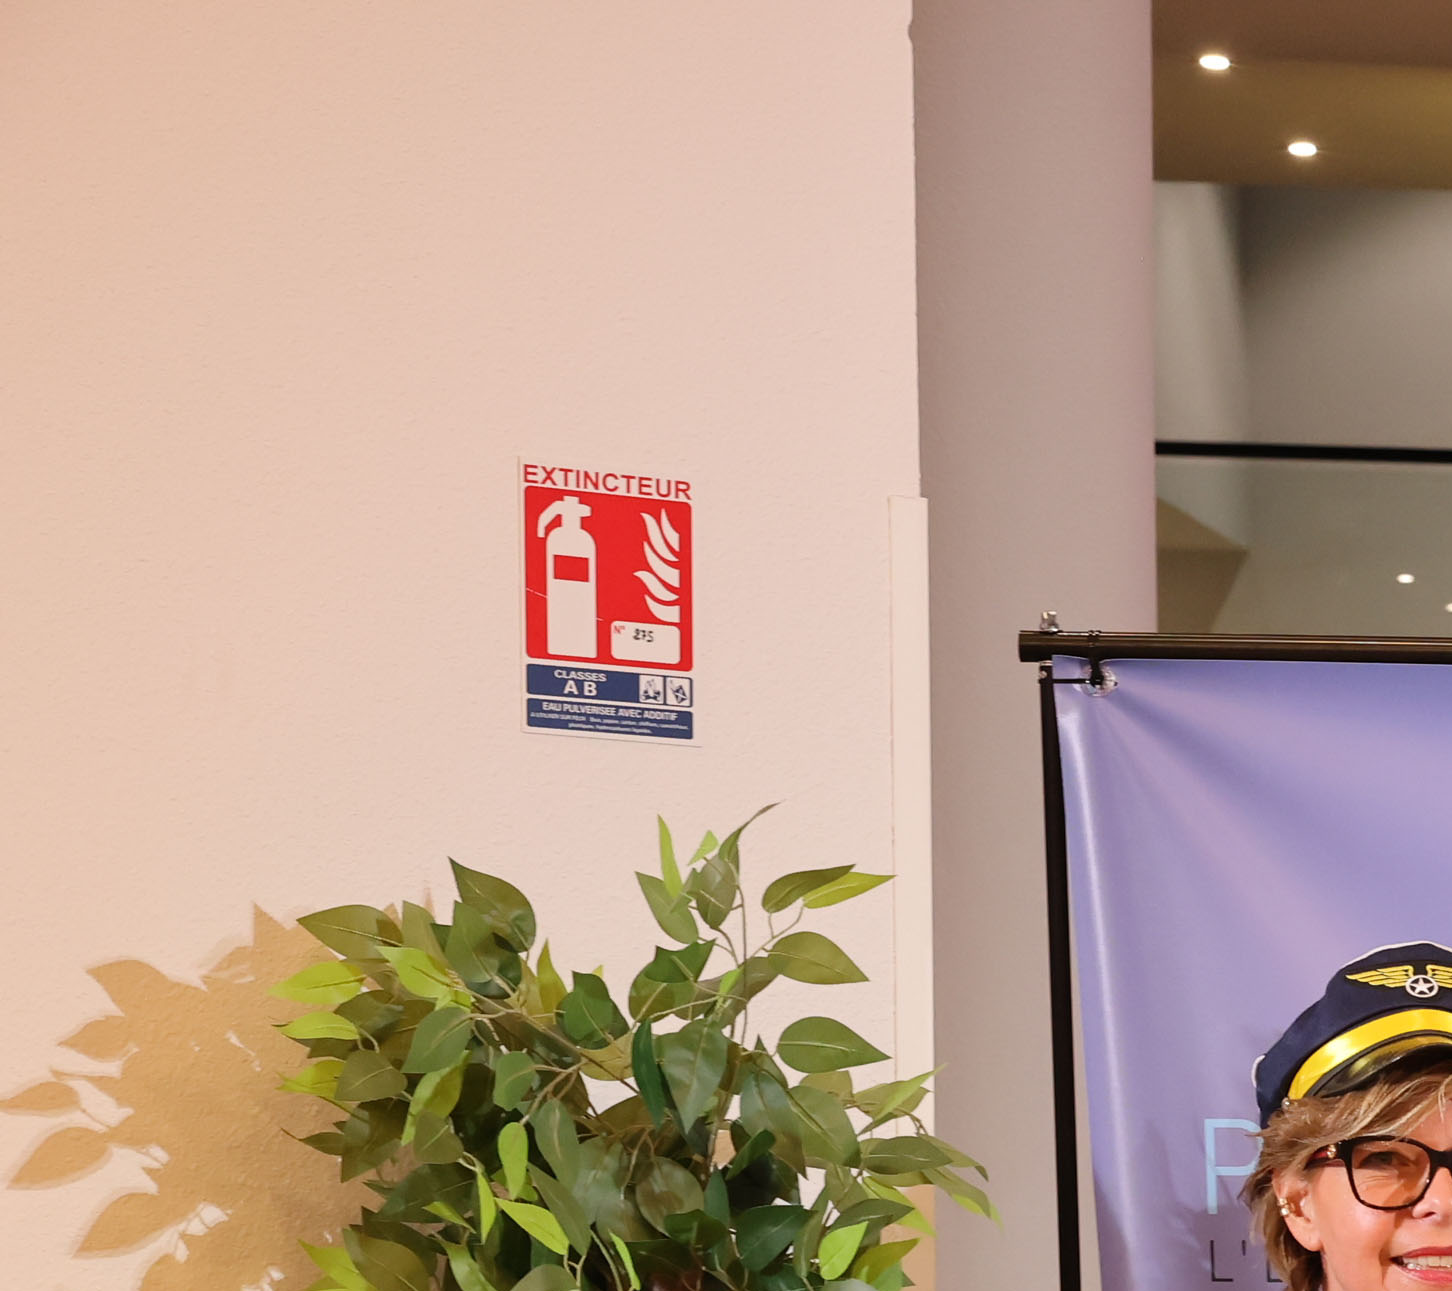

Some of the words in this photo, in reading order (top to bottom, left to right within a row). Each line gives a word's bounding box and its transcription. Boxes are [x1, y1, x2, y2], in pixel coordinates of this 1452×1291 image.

[523, 464, 692, 500] EXTINCTEUR
[554, 669, 607, 682] CLASSES
[563, 680, 579, 695] A
[584, 681, 597, 696] B
[542, 702, 562, 712] EAU
[563, 703, 617, 715] PULVERISEE
[617, 708, 641, 719] AVEC
[643, 710, 678, 721] ADDITIF
